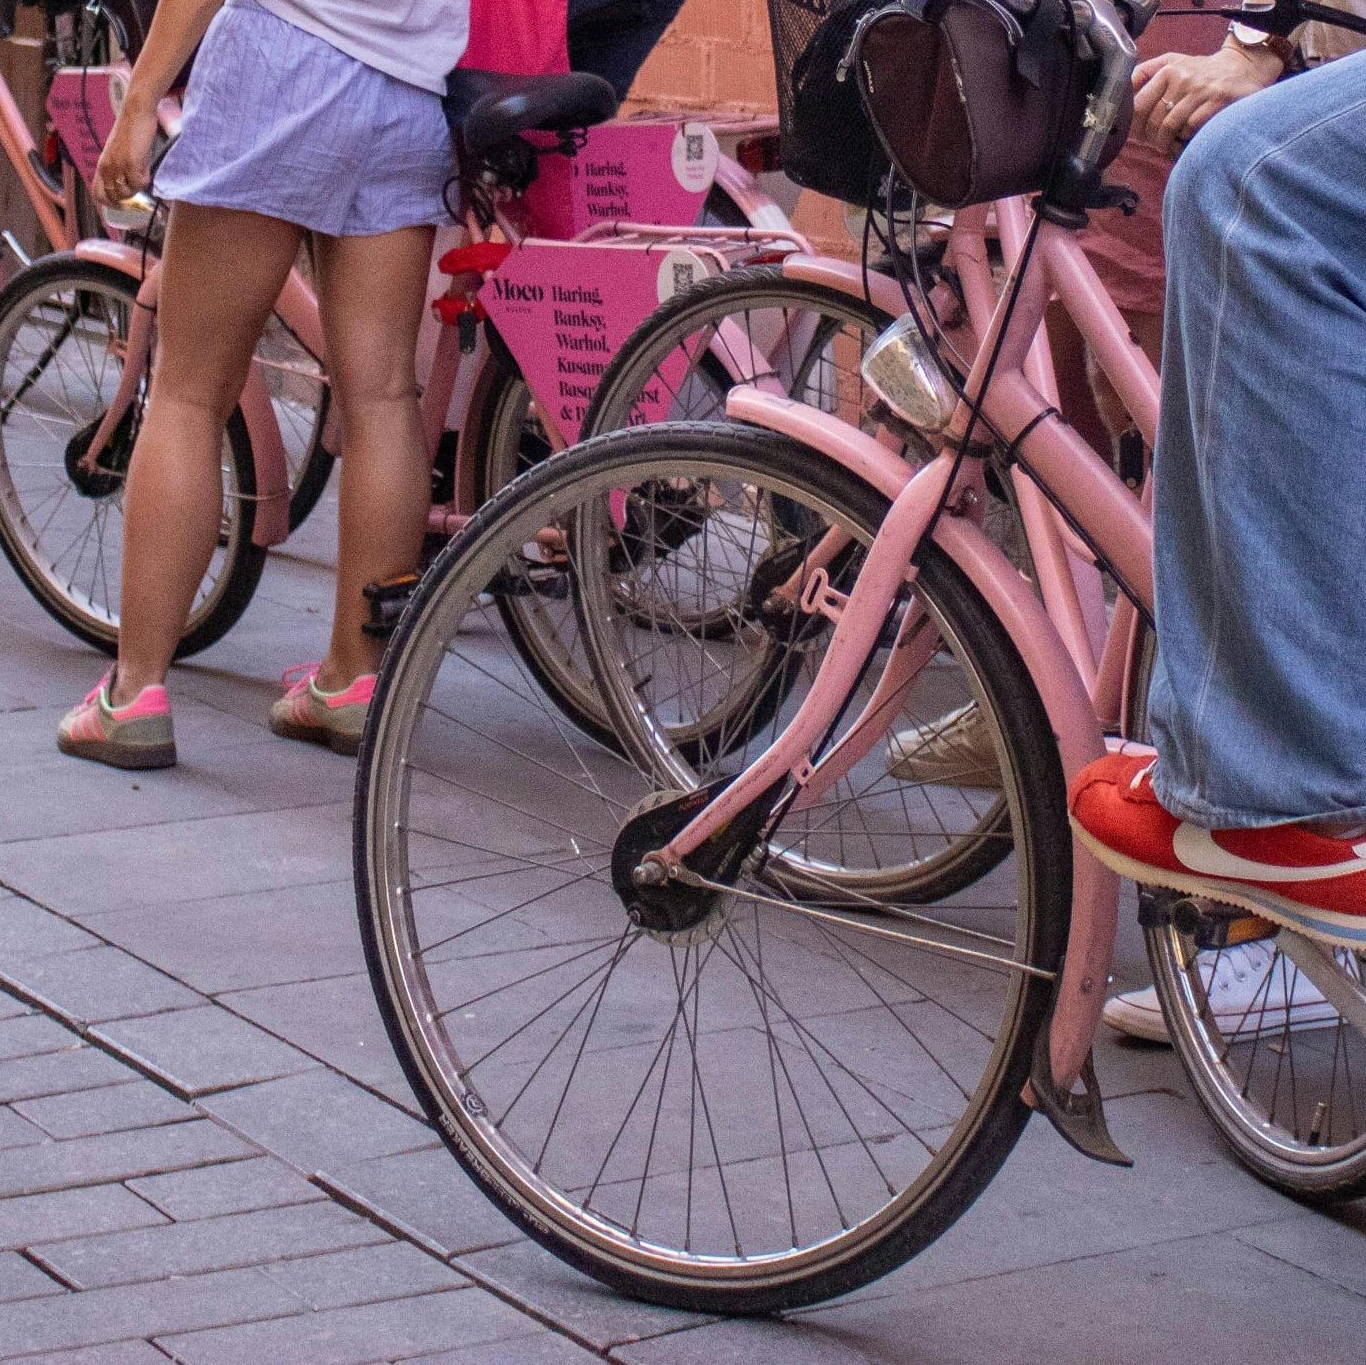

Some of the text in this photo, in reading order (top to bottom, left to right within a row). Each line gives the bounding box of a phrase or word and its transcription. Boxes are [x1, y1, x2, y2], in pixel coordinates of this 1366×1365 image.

[493, 278, 545, 302] Moco
[552, 285, 603, 306] Haring,
[554, 310, 606, 332] Banksy,
[555, 333, 611, 353] Warhol,
